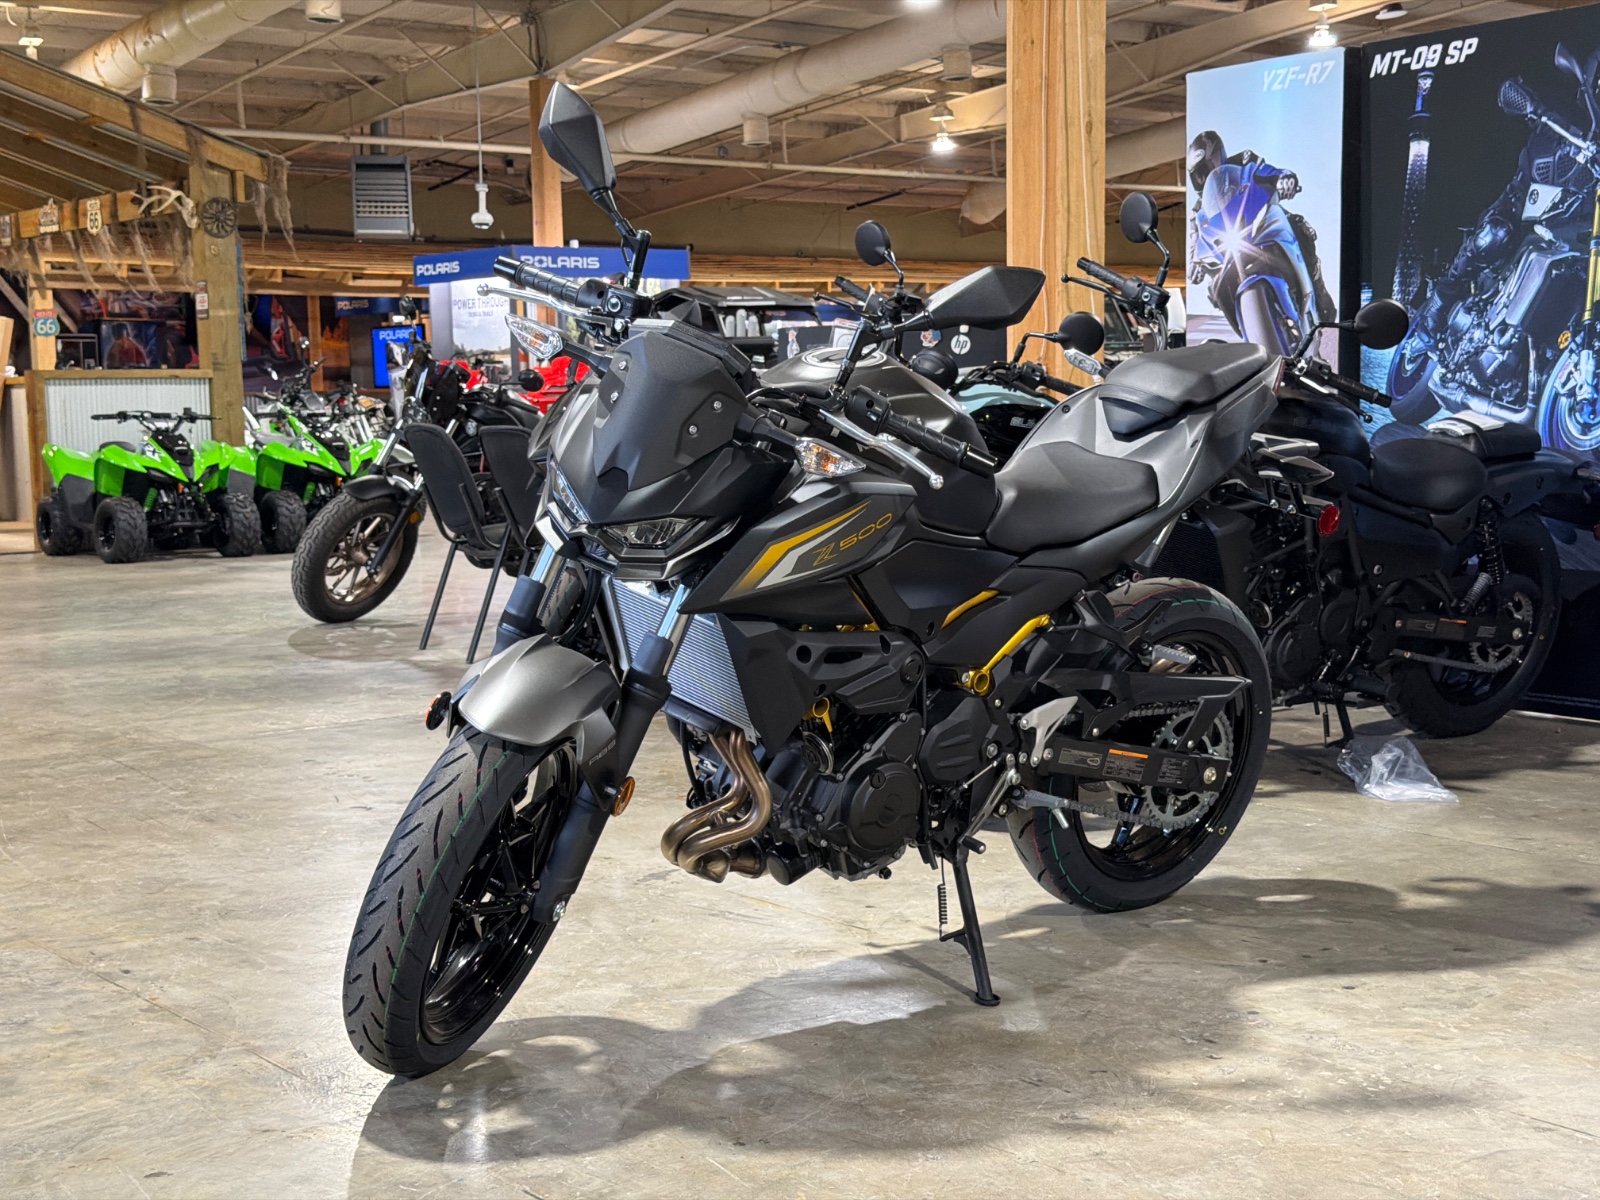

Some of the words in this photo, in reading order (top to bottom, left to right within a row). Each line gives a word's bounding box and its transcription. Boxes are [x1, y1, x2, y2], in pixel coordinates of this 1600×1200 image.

[1369, 43, 1443, 78] MT-09
[1444, 37, 1479, 65] SP
[1262, 60, 1336, 92] YZF-R7
[89, 211, 99, 230] 66
[416, 261, 460, 277] POLARIS
[520, 255, 600, 269] POLARIS
[337, 300, 369, 311] POLARIS
[453, 299, 476, 310] POWER
[37, 319, 55, 334] 66
[953, 335, 968, 353] hp
